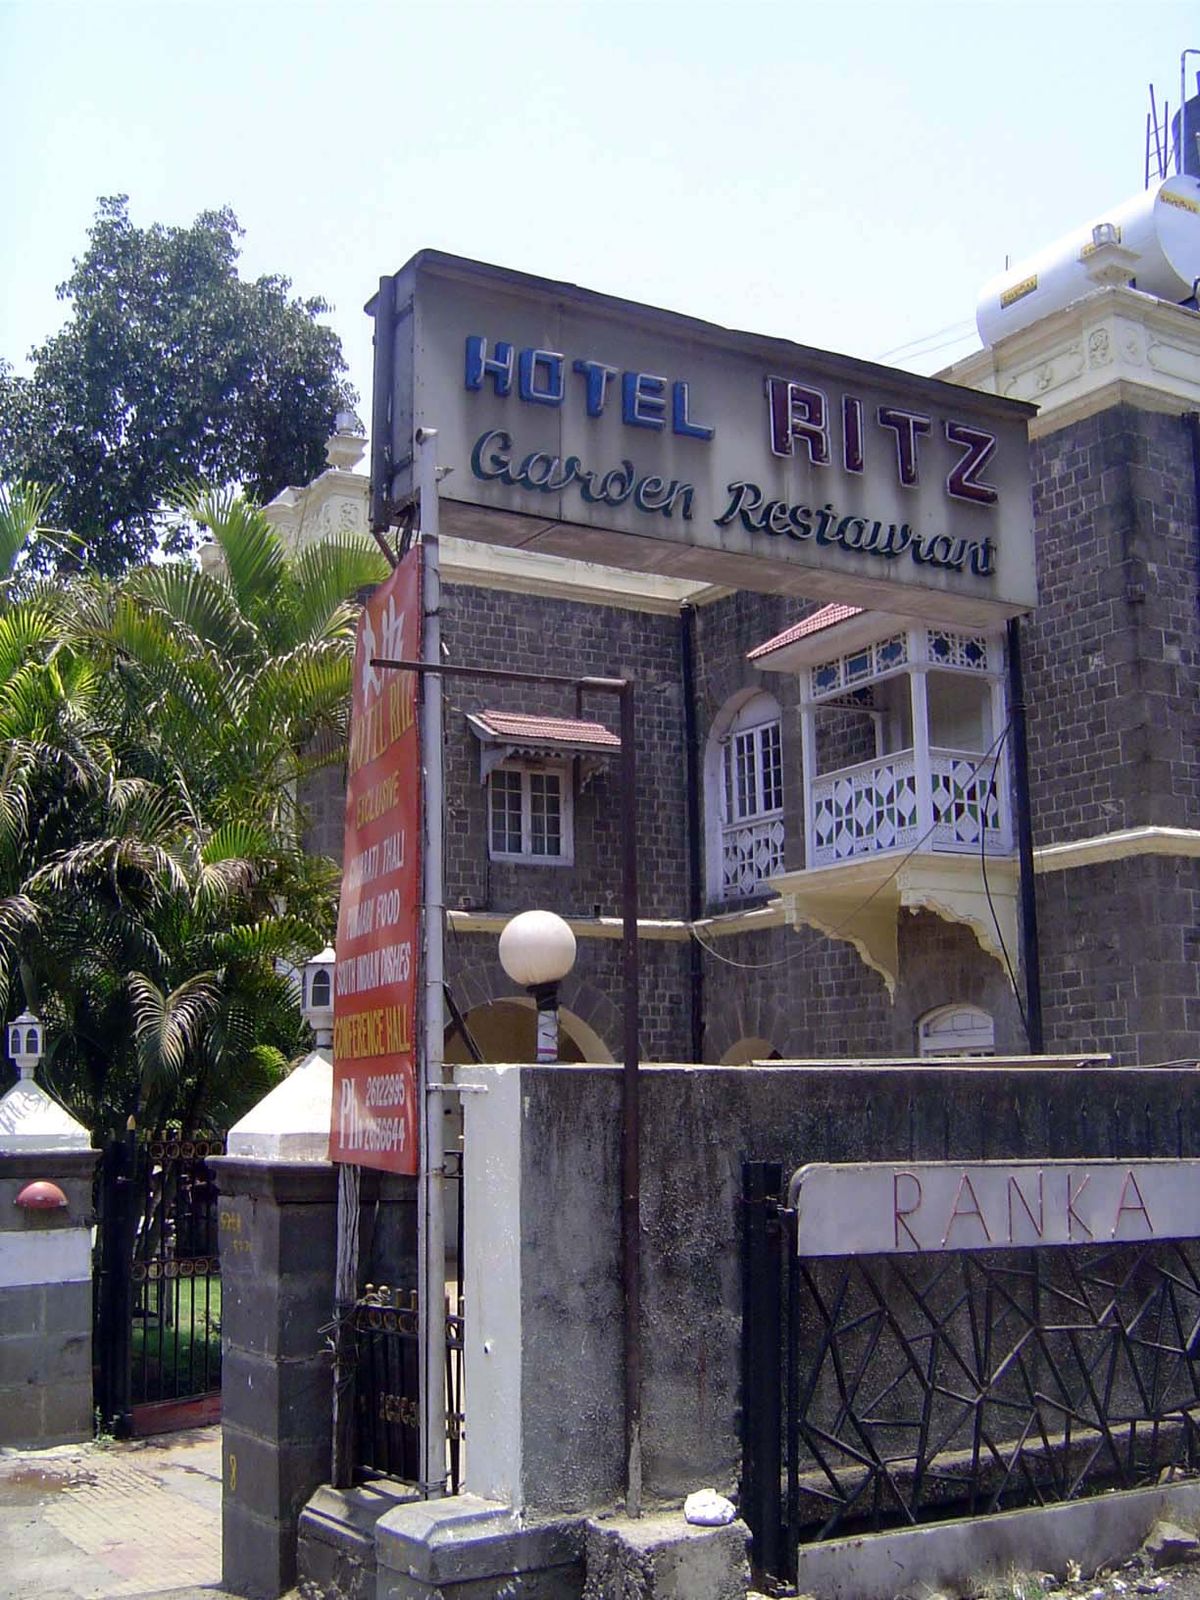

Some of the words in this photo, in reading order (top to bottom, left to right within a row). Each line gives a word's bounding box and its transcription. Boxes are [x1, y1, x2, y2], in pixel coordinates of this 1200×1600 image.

[465, 335, 716, 441] HOTEL
[765, 375, 998, 507] RITZ
[471, 429, 694, 520] Garden
[714, 481, 998, 576] Restaurant
[391, 668, 415, 744] RITZ
[383, 829, 405, 876] THALI
[346, 898, 375, 941] PJABI
[376, 888, 400, 930] FOOD
[337, 956, 357, 997] SOUTH
[357, 950, 380, 993] INDIAN
[380, 942, 411, 986] DISHES
[334, 1008, 385, 1060] CONFERENCE
[385, 1004, 410, 1053] HALL
[893, 1170, 1154, 1249] RANKA
